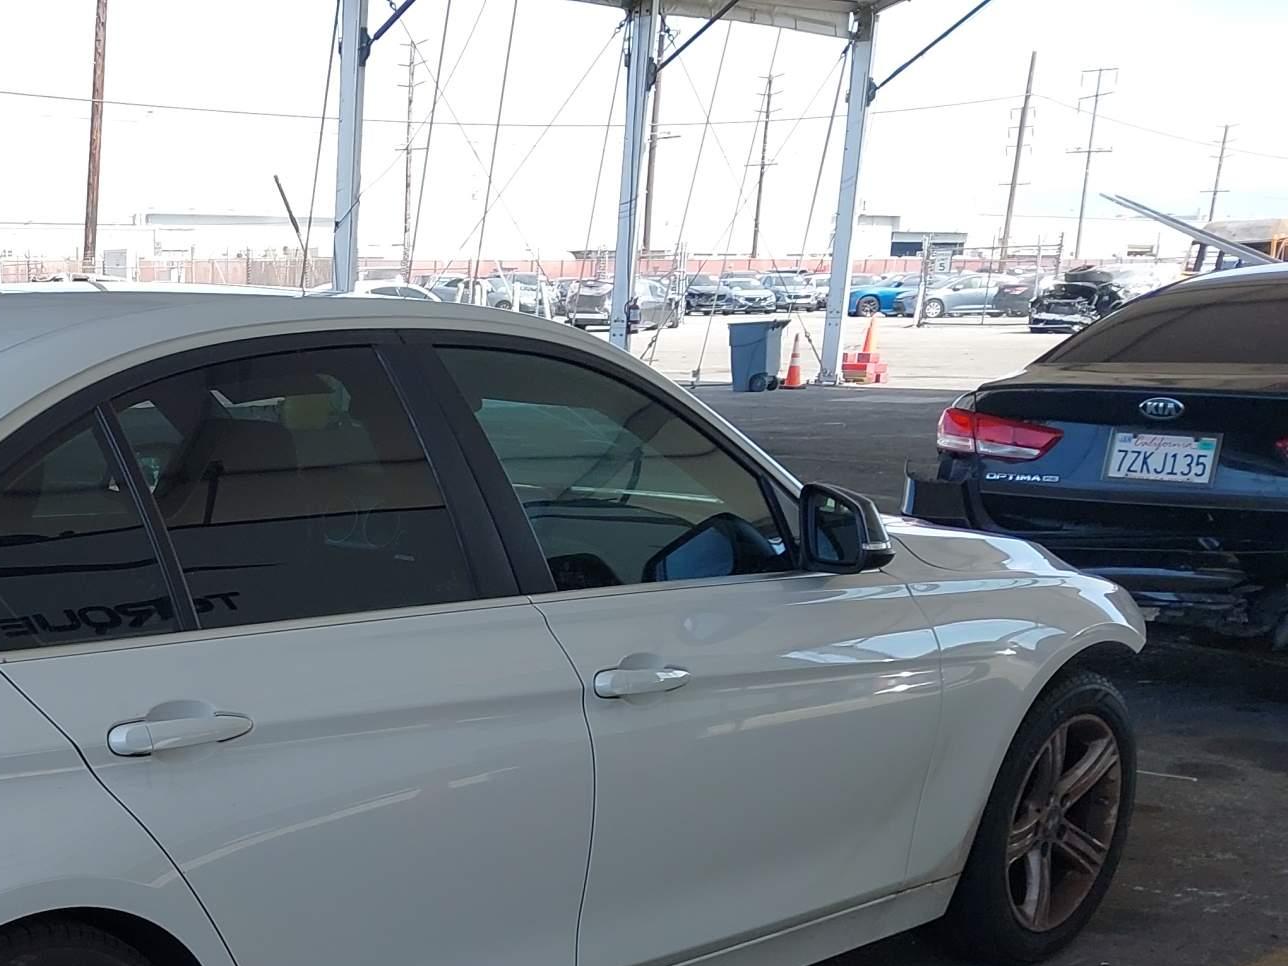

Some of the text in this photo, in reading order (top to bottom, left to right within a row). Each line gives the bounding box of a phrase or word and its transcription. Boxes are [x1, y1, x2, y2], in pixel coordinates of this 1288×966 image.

[1146, 401, 1177, 416] KIA
[1134, 436, 1194, 451] California
[1116, 449, 1209, 478] 7ZKJ135
[985, 472, 1042, 482] OPTIMA
